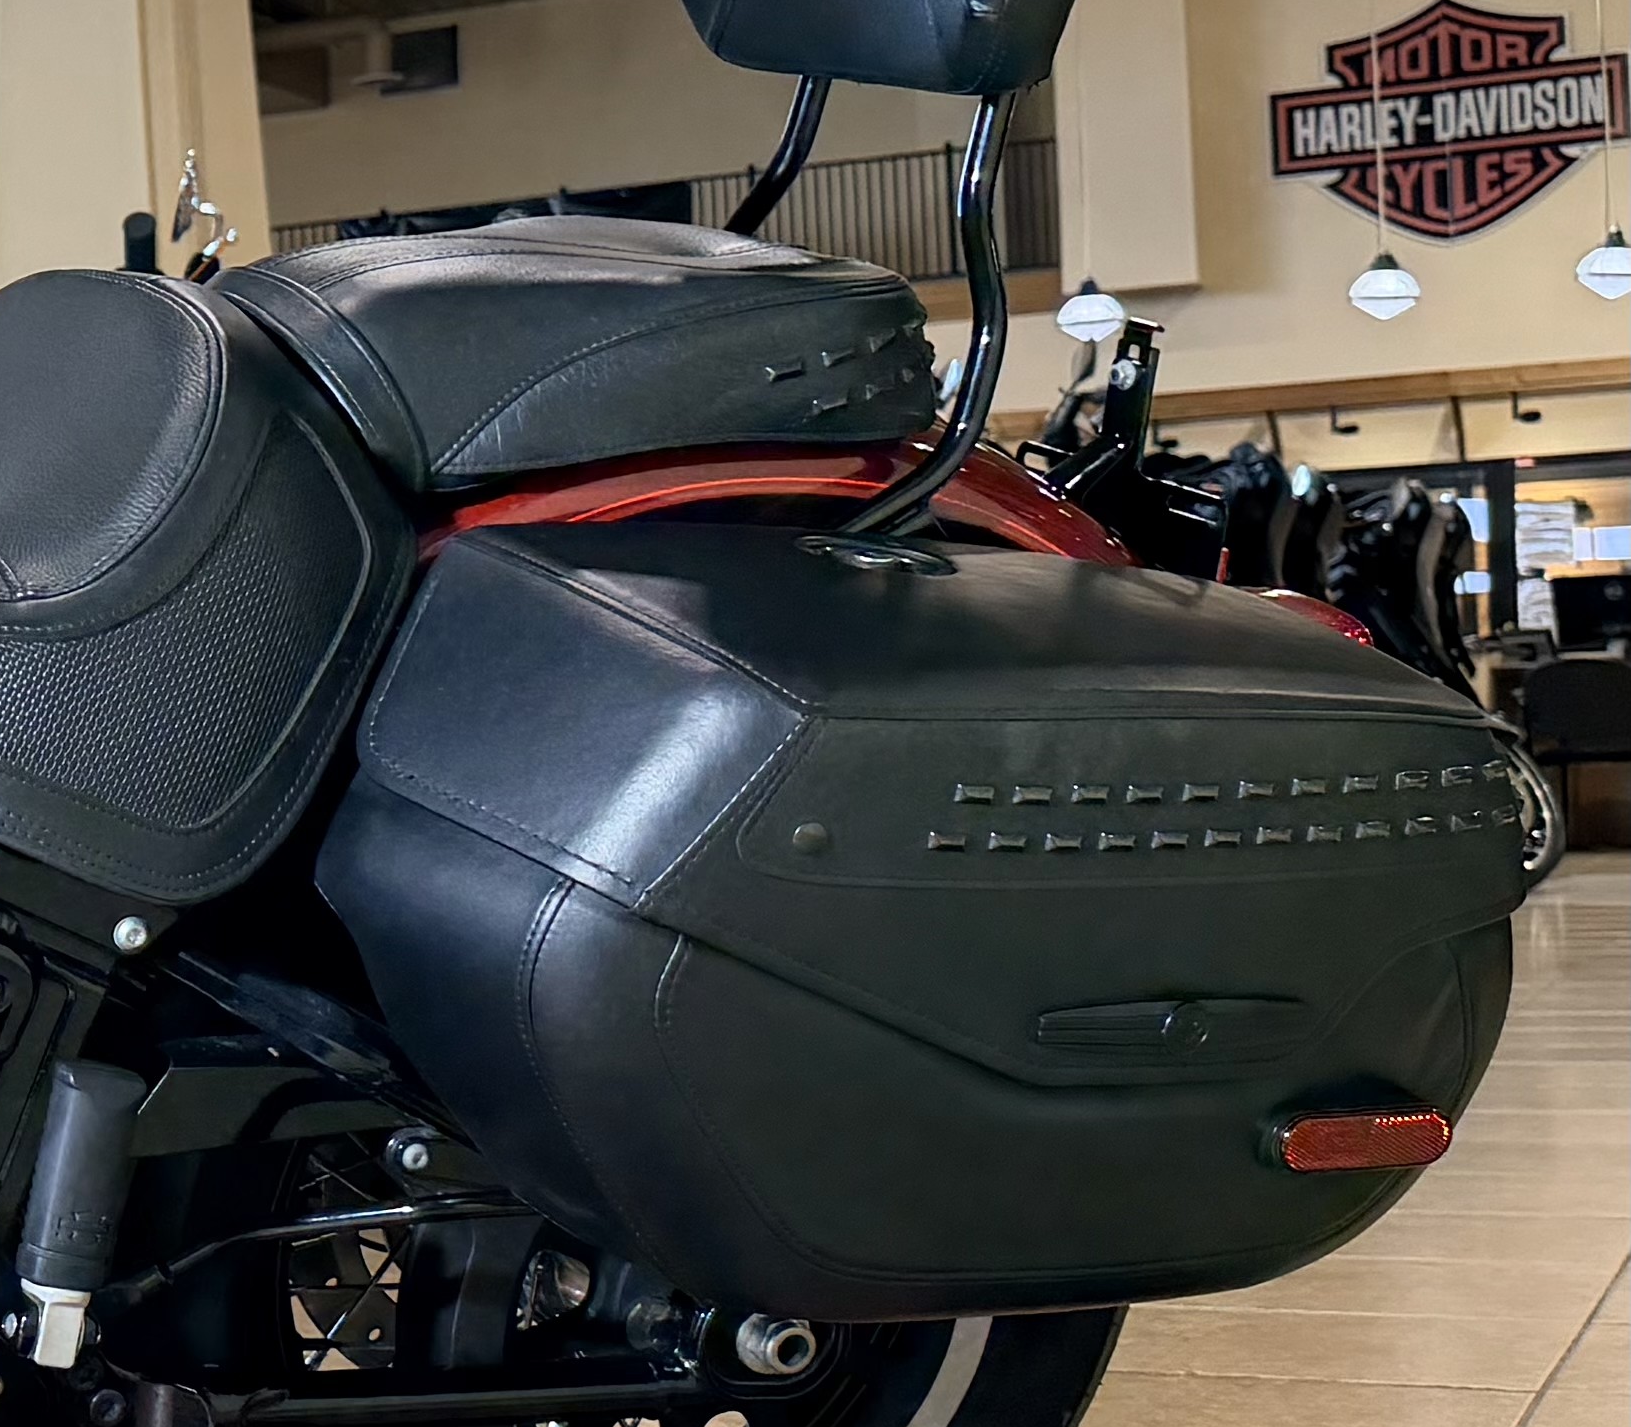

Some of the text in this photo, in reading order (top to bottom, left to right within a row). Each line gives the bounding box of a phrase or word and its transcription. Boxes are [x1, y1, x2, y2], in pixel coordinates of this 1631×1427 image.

[1363, 22, 1530, 86] MOTOR
[1291, 74, 1607, 158] HARLEY-DAVIDSON
[1365, 145, 1536, 220] CYCLES
